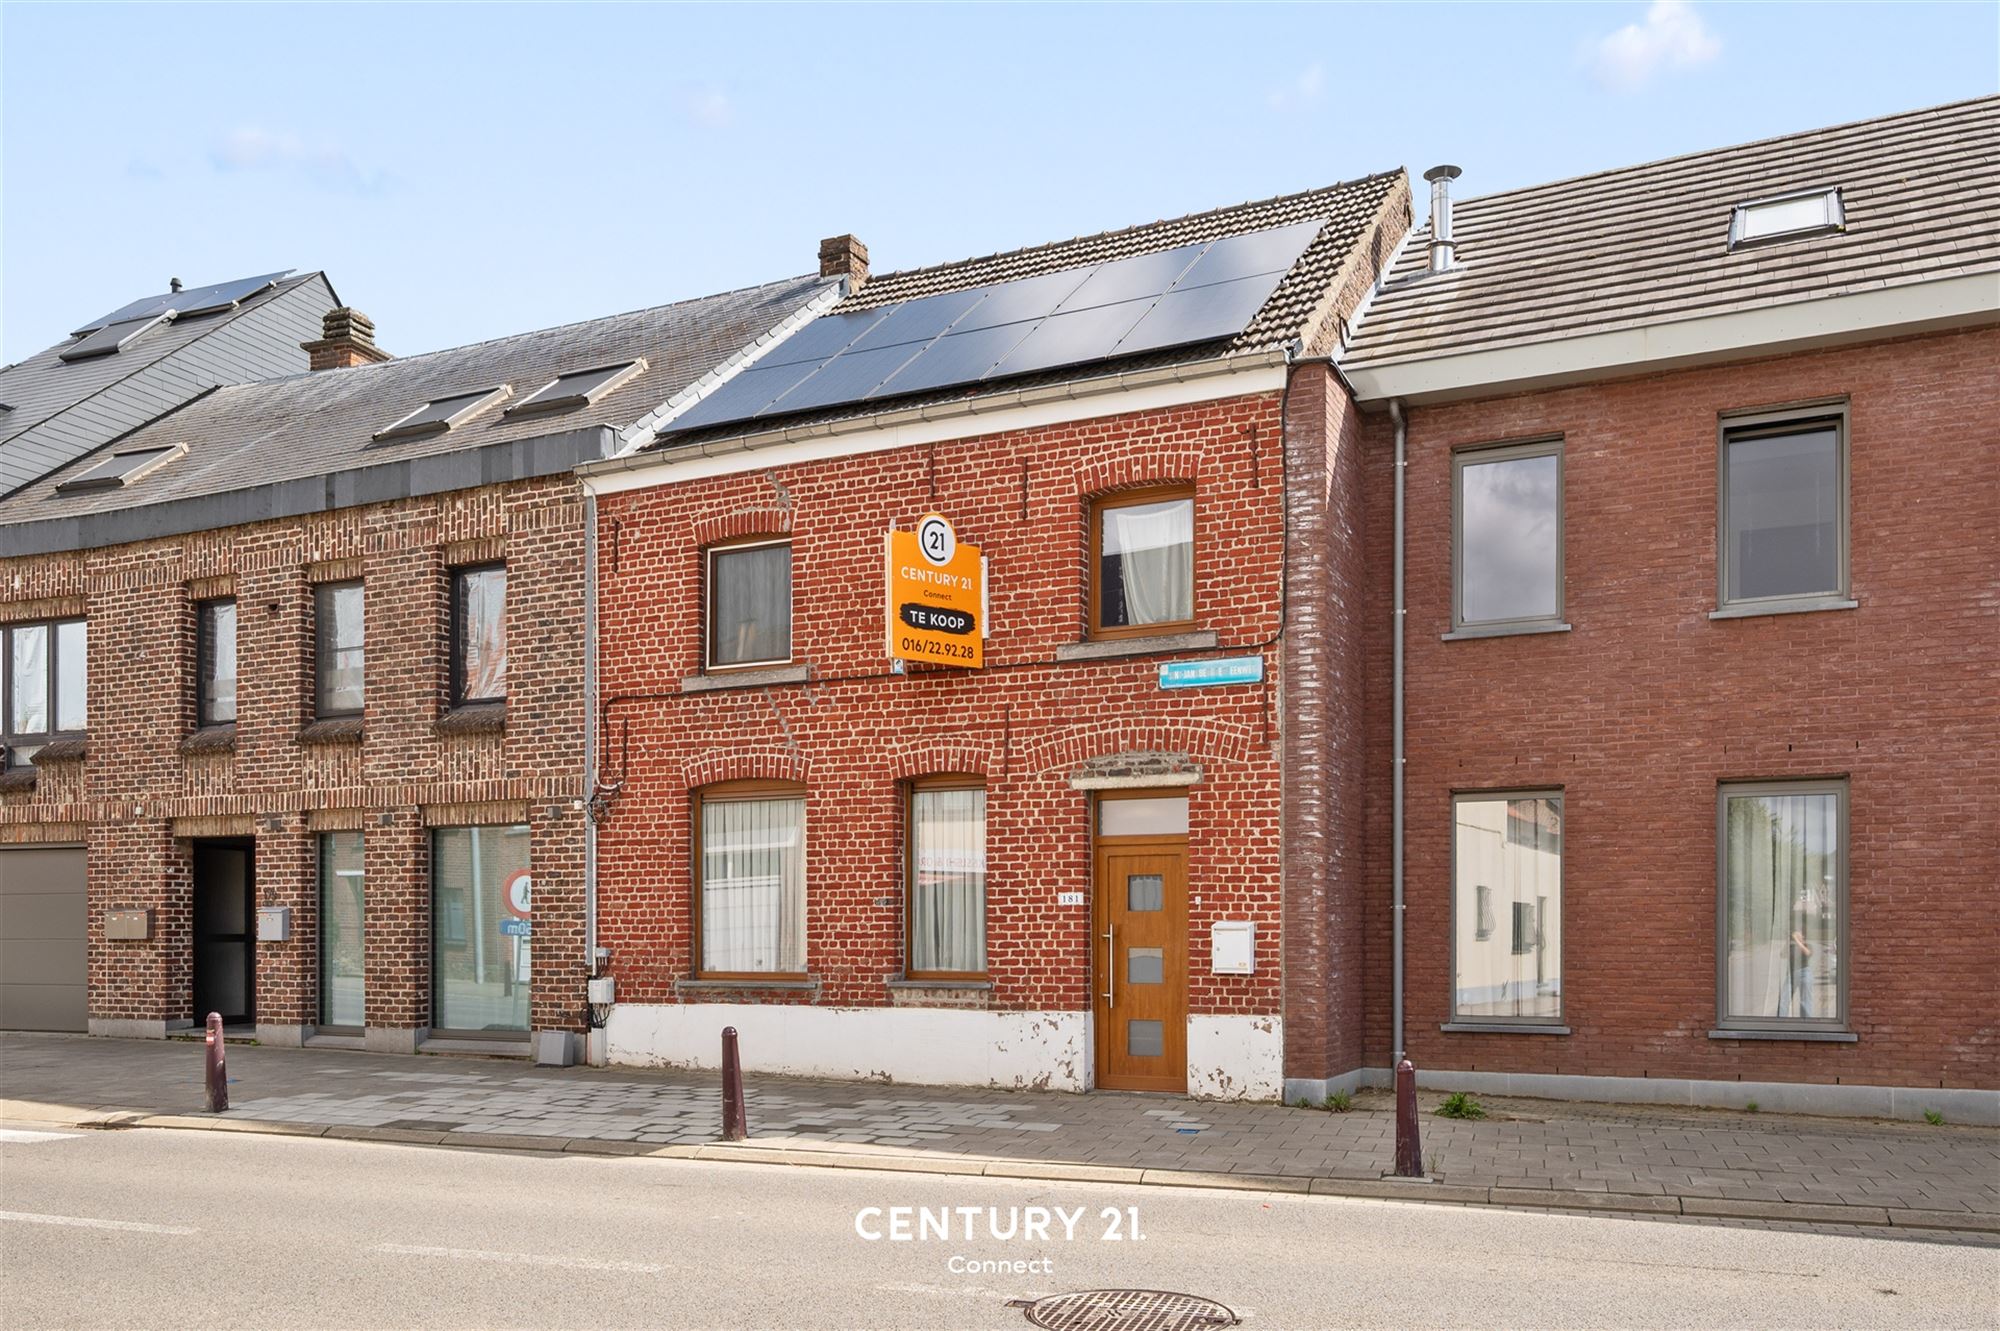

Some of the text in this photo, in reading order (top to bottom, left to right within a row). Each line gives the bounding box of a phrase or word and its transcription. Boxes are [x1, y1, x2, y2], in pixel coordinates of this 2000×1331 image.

[901, 566, 973, 590] CENTURY 21
[923, 589, 952, 601] Connect
[909, 610, 965, 629] TE KOOP
[902, 637, 974, 659] 016/22.92.28
[1062, 895, 1079, 903] 181
